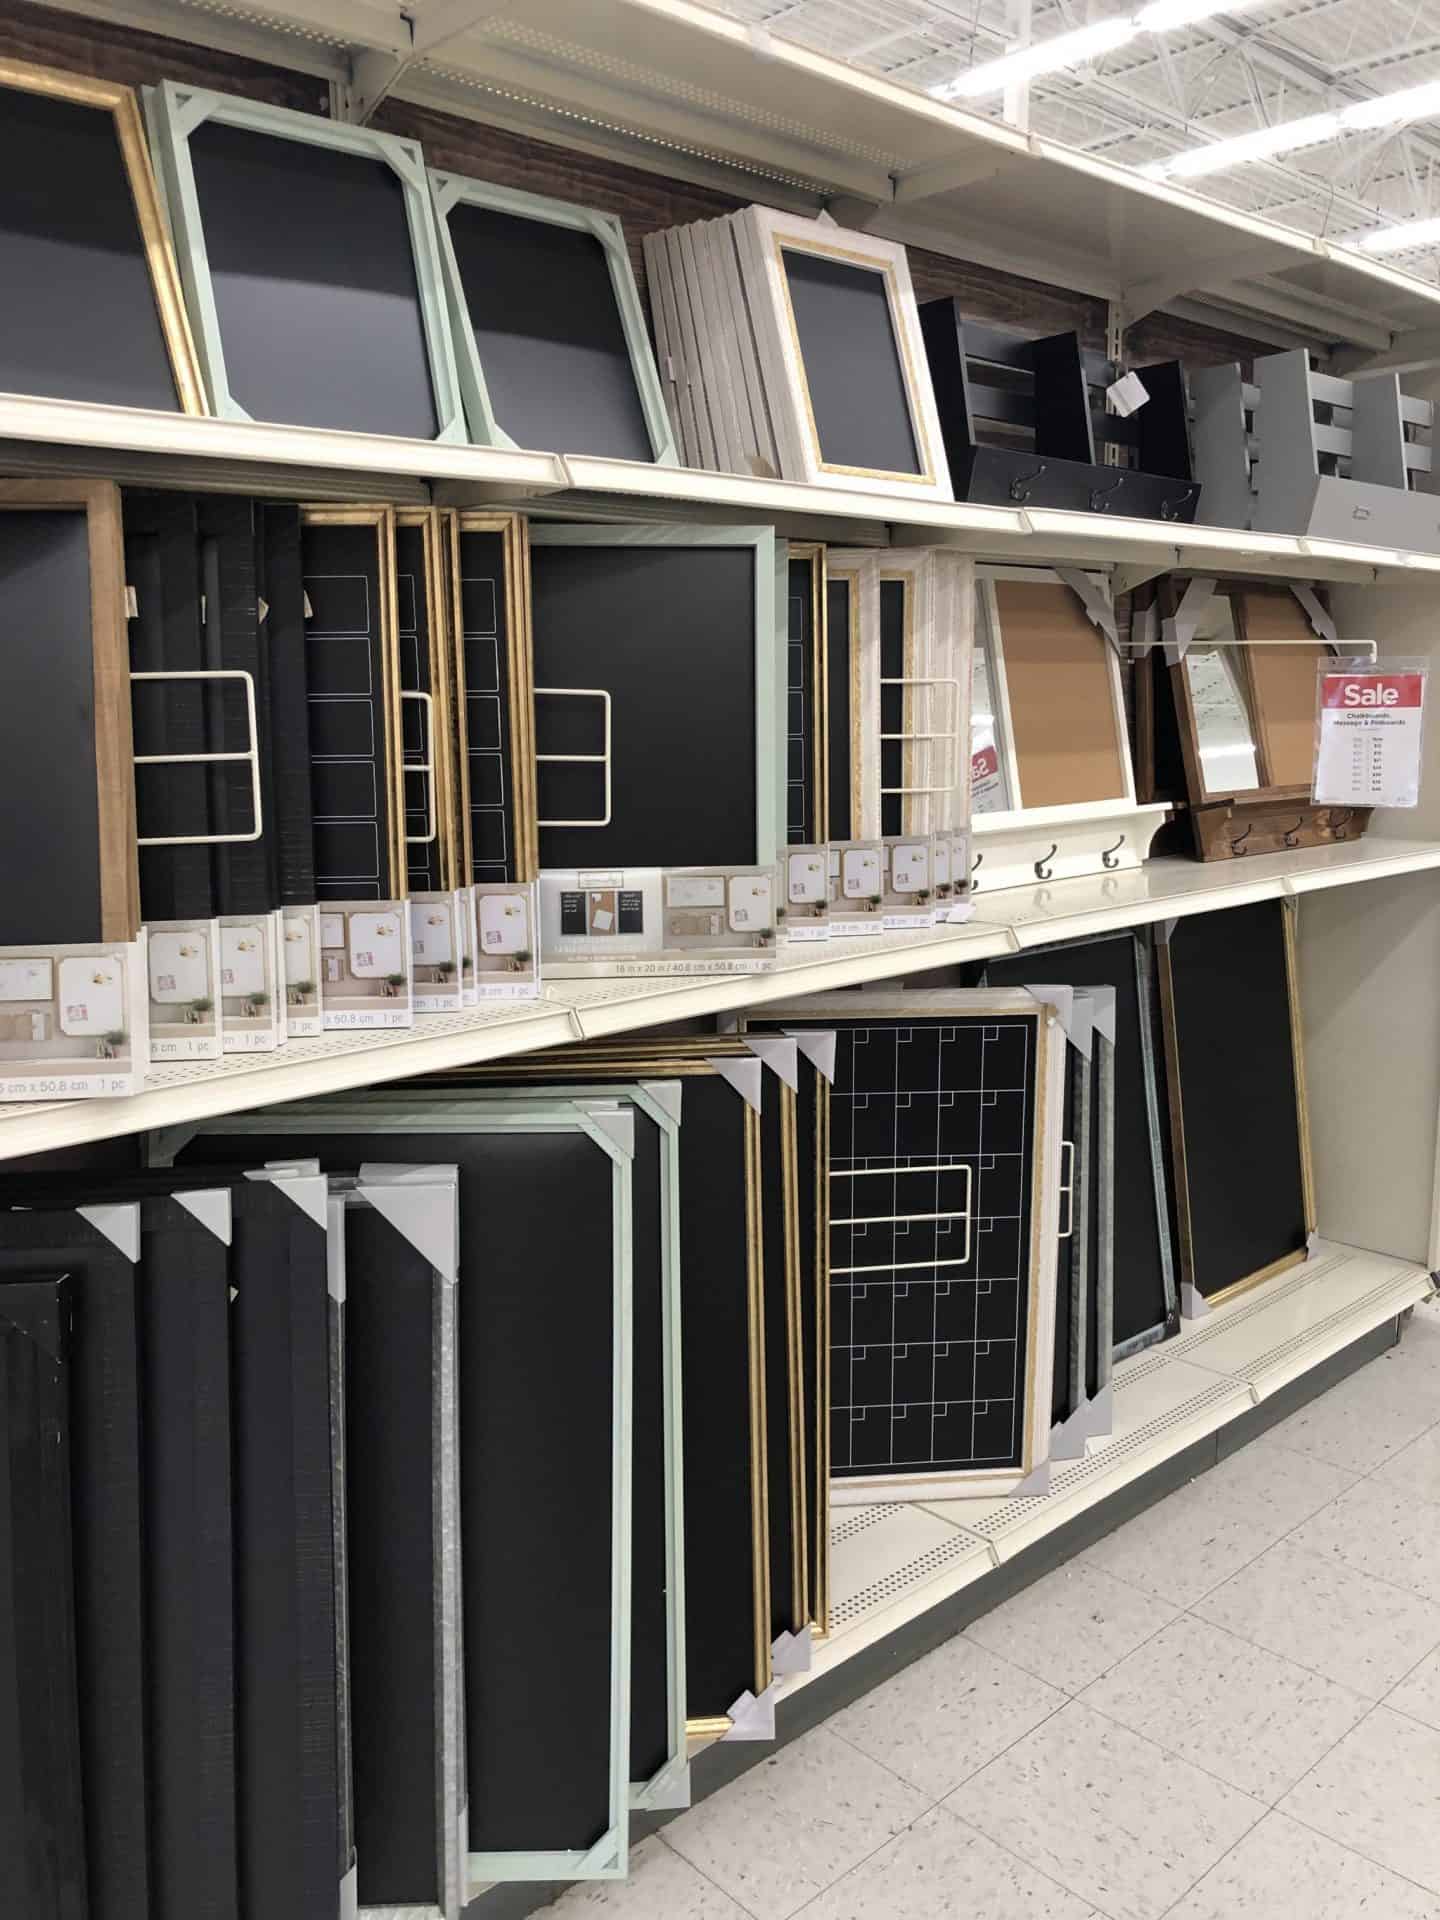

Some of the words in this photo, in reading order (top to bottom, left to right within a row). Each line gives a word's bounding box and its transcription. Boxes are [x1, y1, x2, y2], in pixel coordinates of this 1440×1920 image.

[1344, 682, 1399, 706] Sale
[161, 1043, 177, 1052] cm
[8, 1083, 26, 1093] cm
[40, 1080, 66, 1093] 50.8
[72, 1081, 88, 1090] cm
[111, 1080, 127, 1091] pc
